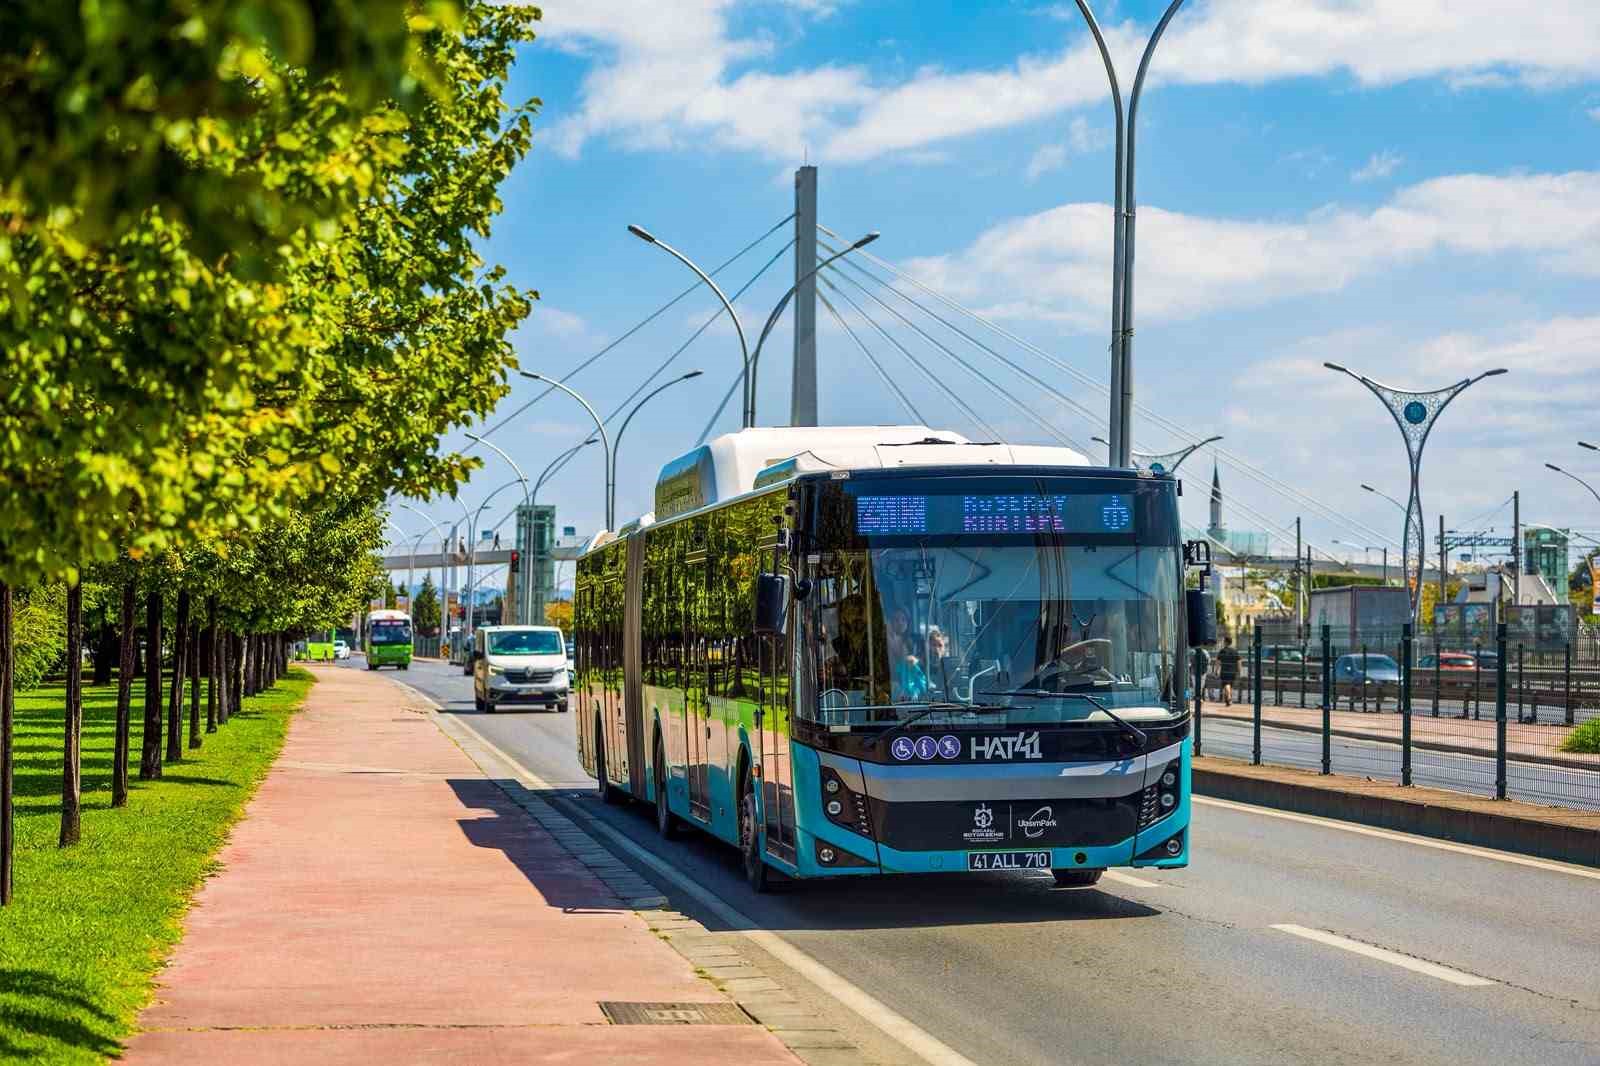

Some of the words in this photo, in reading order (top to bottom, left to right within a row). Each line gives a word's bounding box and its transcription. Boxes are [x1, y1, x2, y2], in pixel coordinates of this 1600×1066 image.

[973, 854, 988, 869] 41
[992, 853, 1021, 868] ALL
[1025, 852, 1047, 868] 710
